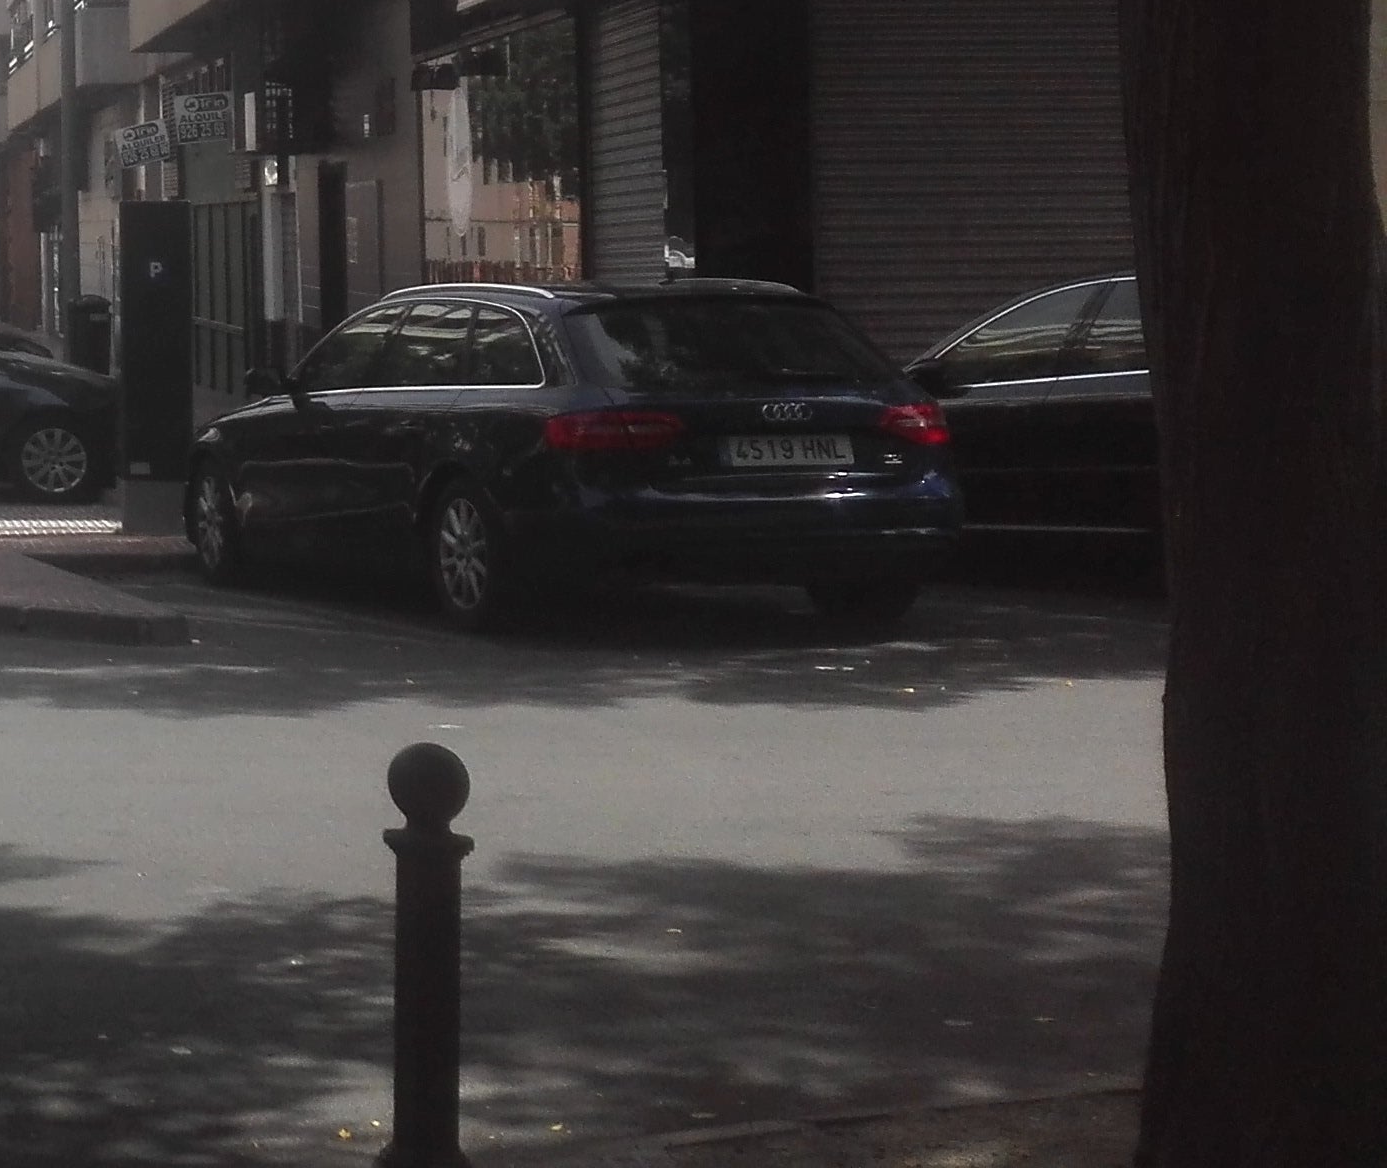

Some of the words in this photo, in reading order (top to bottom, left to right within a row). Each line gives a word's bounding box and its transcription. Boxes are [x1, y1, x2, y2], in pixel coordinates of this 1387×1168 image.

[149, 262, 163, 278] P
[737, 439, 794, 460] 4519
[803, 438, 846, 460] HNL
